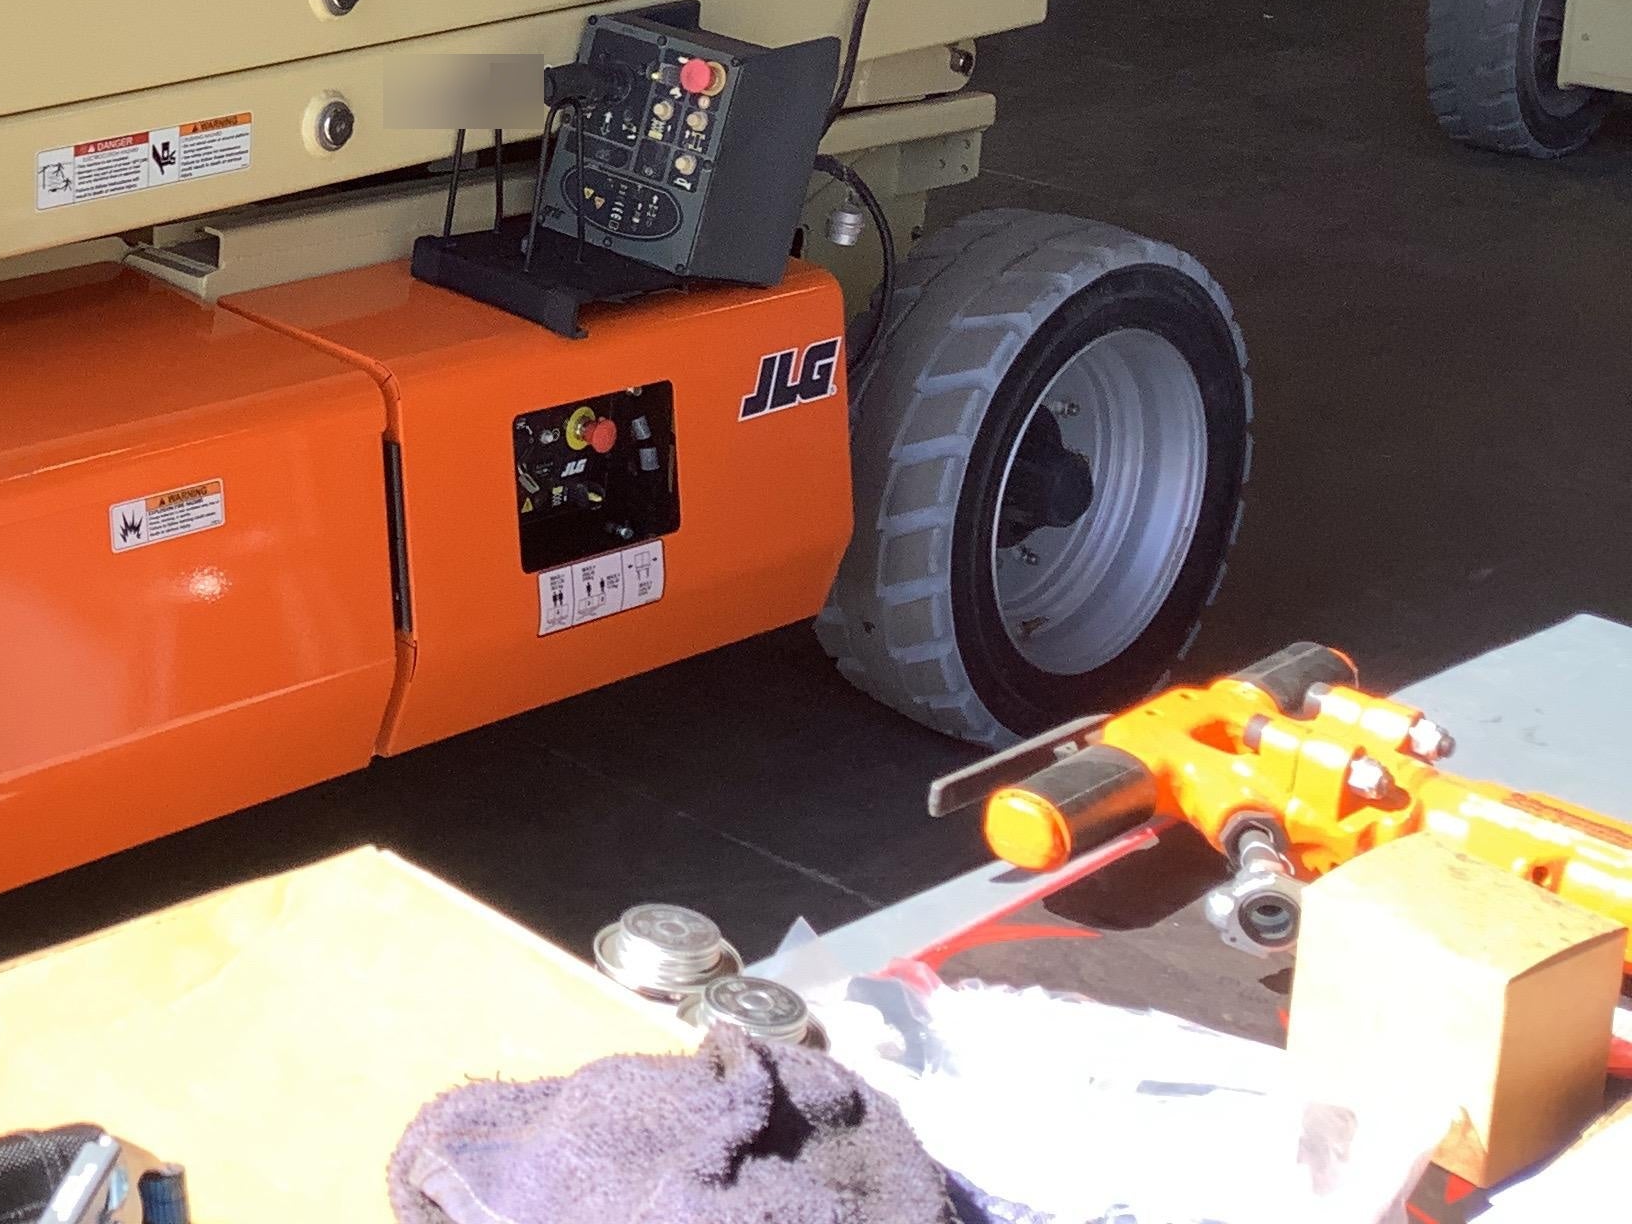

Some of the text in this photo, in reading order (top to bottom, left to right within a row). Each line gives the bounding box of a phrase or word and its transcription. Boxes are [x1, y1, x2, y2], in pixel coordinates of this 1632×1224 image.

[96, 136, 134, 152] DANGER
[737, 335, 842, 422] JLG
[560, 458, 587, 478] JLG
[168, 485, 208, 504] WARNING
